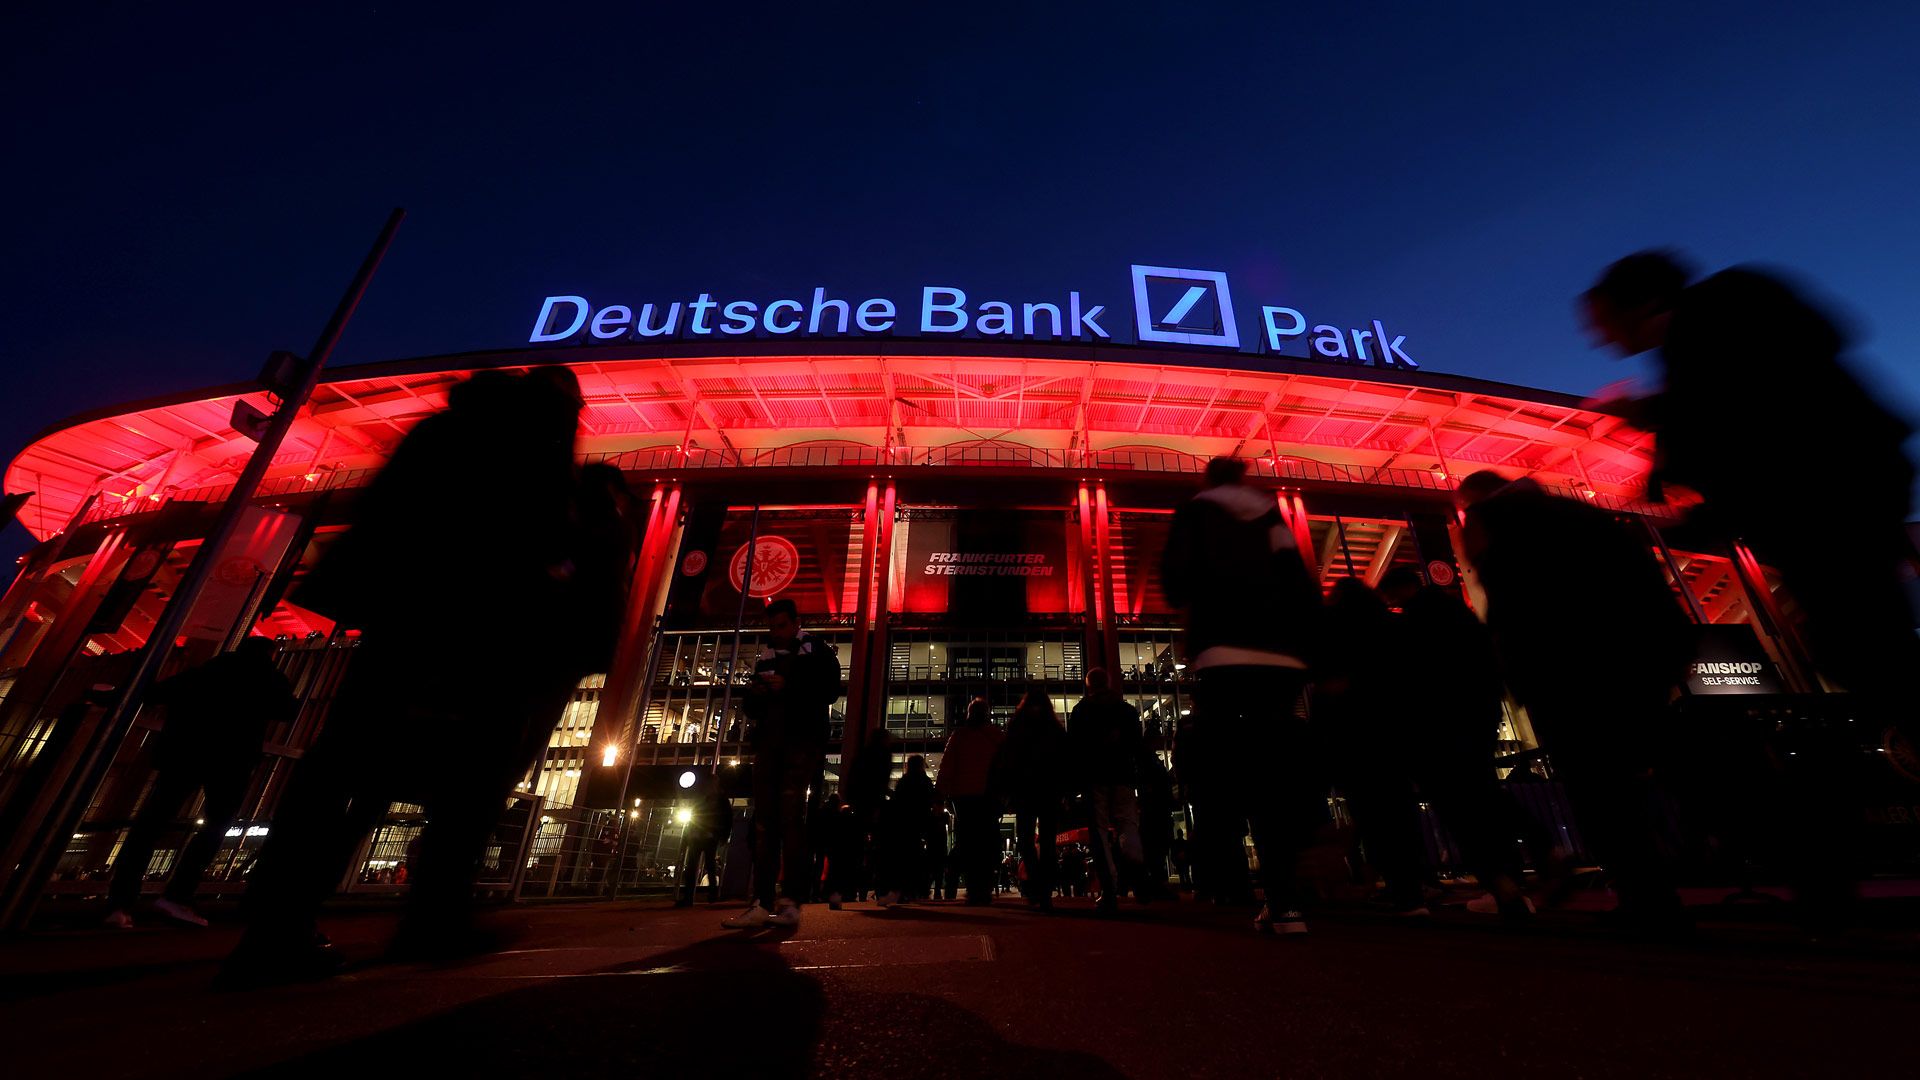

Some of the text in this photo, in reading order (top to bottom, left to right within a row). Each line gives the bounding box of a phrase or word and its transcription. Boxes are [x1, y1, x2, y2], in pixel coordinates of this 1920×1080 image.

[529, 286, 1419, 367] Deutsche Bank Park
[929, 552, 1046, 564] FRANKFURTER
[924, 565, 1054, 576] STERNSTUNDEN
[1702, 676, 1760, 685] SELF-SERVICE
